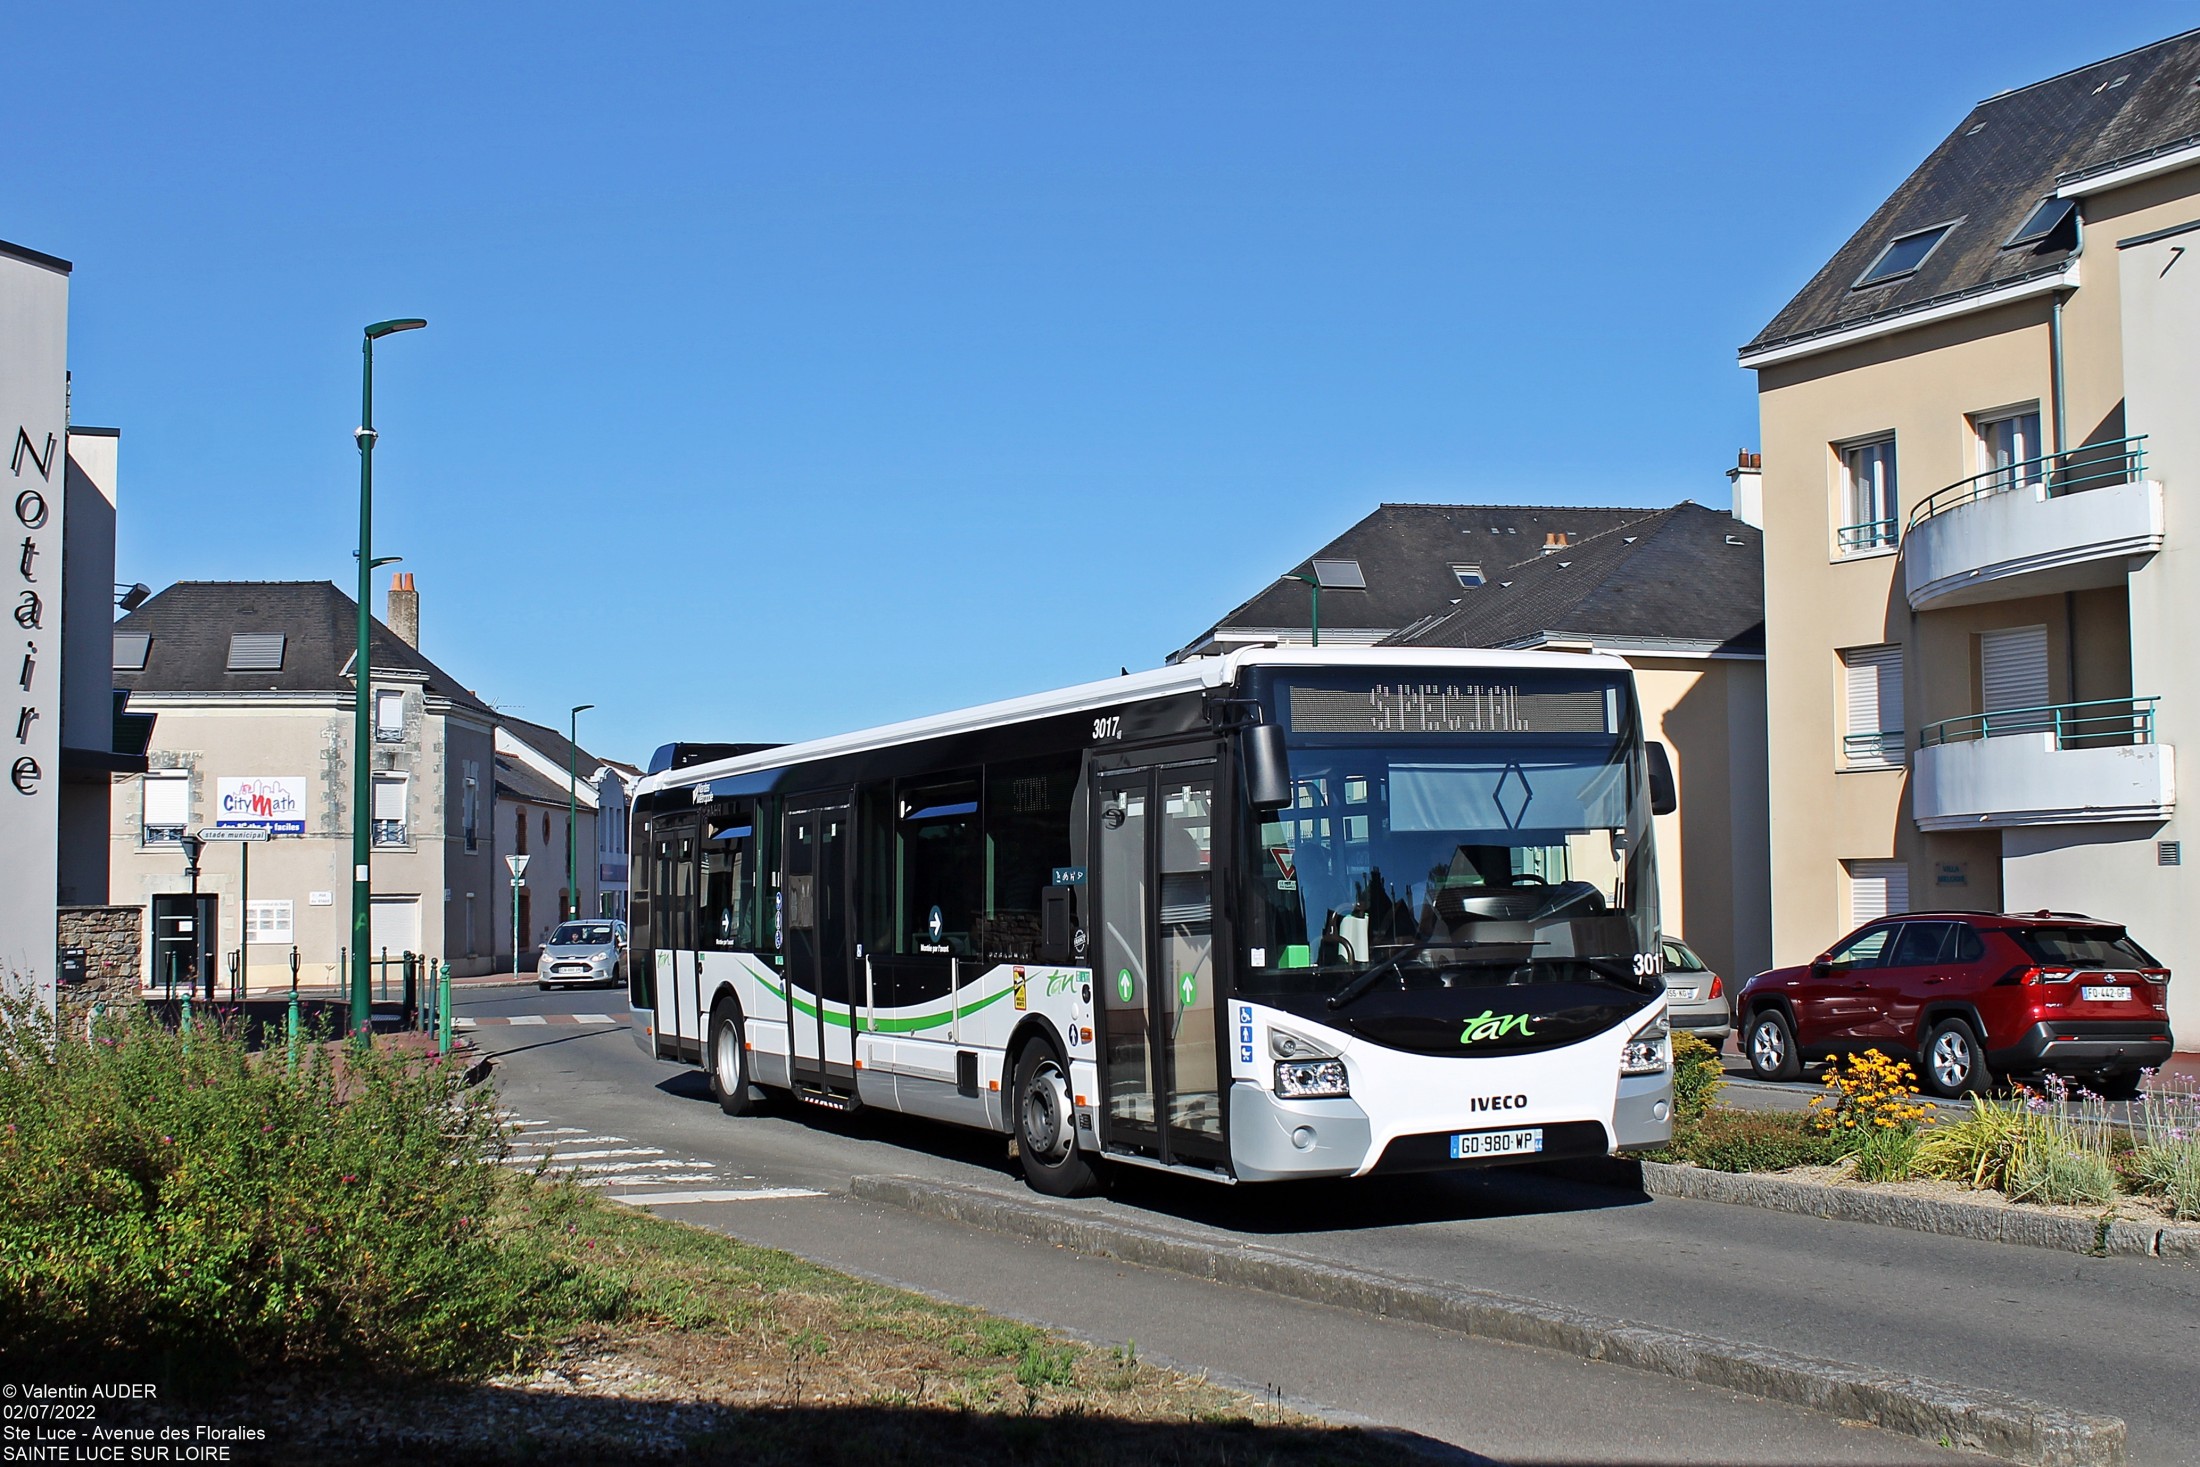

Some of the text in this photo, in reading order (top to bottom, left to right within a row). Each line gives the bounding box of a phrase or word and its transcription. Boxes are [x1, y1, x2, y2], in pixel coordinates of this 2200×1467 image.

[10, 425, 55, 791] Notaire
[1369, 684, 1529, 731] SPECIAL
[1092, 716, 1120, 739] 3017
[205, 831, 264, 839] stade municipal
[274, 823, 300, 831] faciles
[1044, 969, 1077, 997] tan
[1460, 1010, 1536, 1044] tan
[1470, 1094, 1528, 1112] IVECO
[1462, 1132, 1533, 1154] GD-980-WP
